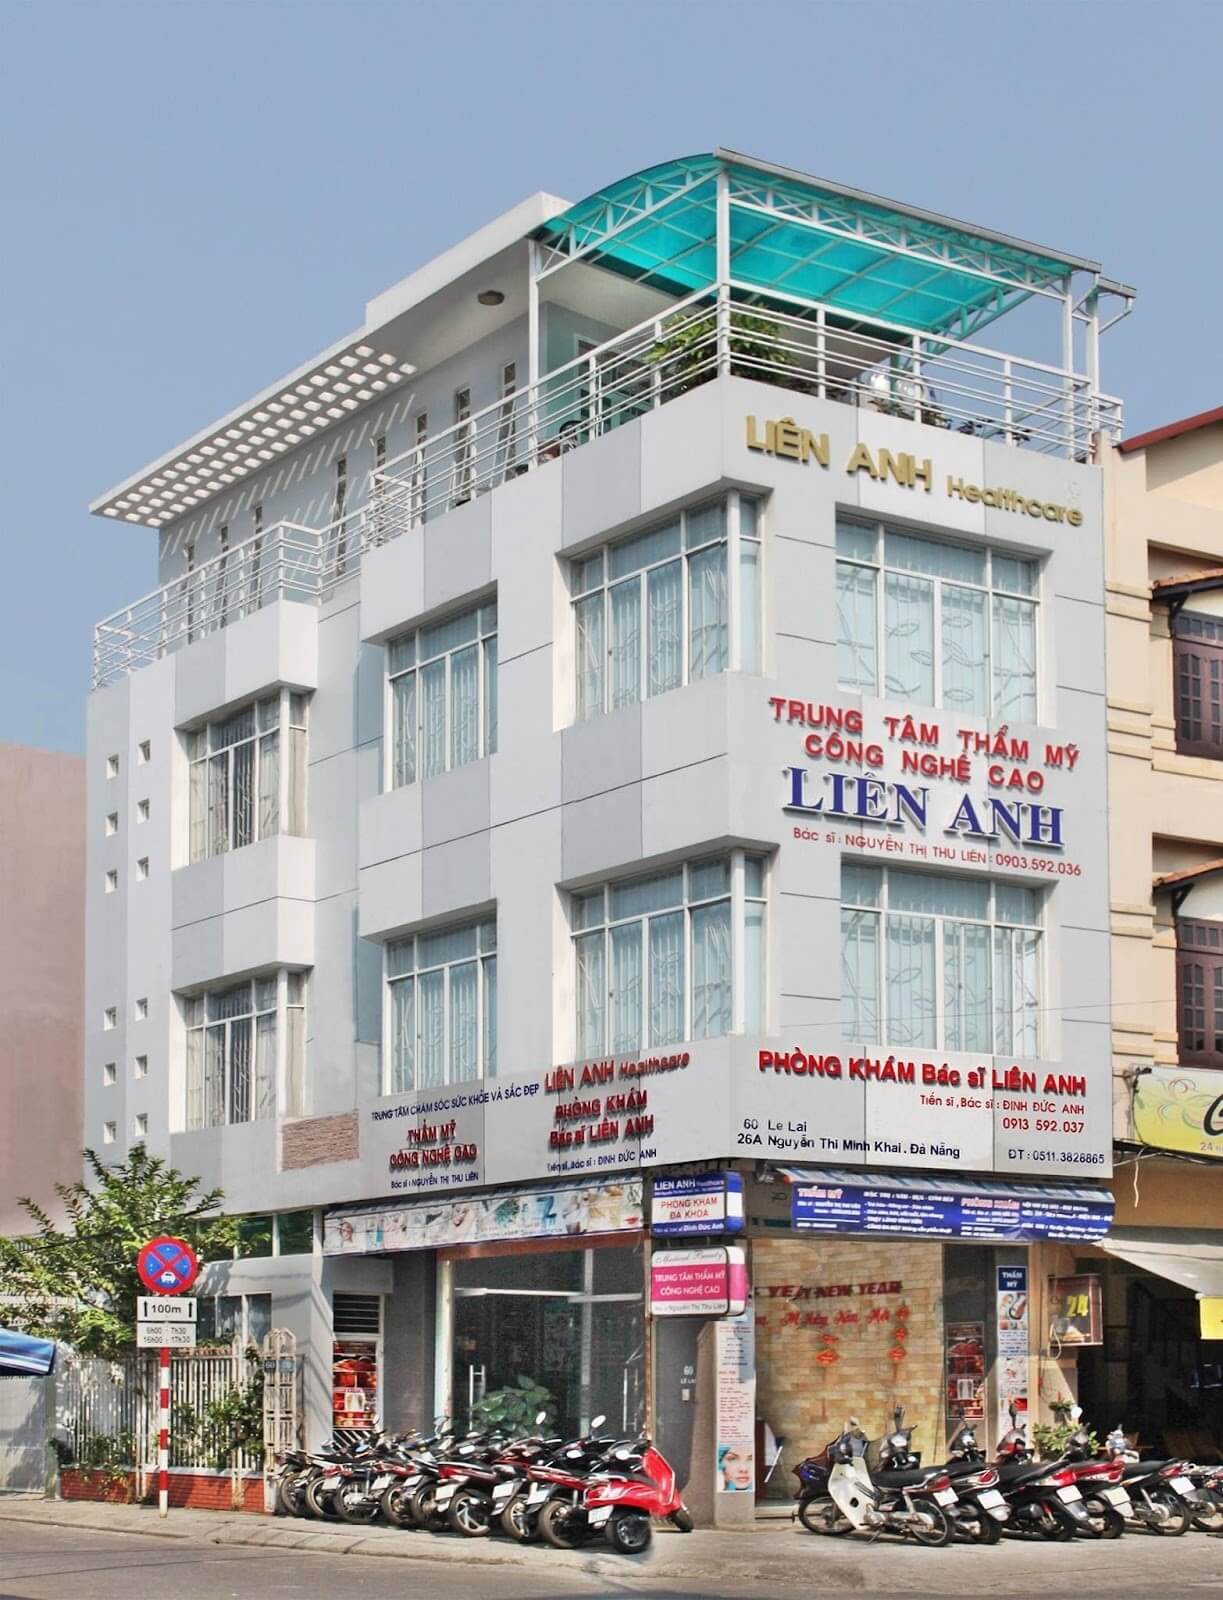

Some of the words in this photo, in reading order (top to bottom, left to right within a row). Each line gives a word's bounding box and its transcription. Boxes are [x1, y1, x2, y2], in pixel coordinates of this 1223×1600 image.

[746, 414, 831, 468] LIÊN
[846, 442, 932, 492] ANH
[946, 474, 1084, 527] Healthcare
[769, 697, 863, 733] TRUNG
[884, 714, 939, 745] TÂM
[958, 725, 1029, 760] THẨM
[1045, 743, 1079, 768] MỸ
[805, 732, 884, 767] CÔNG
[988, 765, 1045, 793] CAO
[783, 767, 929, 829] LIÊN
[945, 793, 1064, 848] ANH
[793, 827, 819, 841] Bác
[845, 834, 903, 852] NGUYỄN
[910, 843, 928, 858] THỊ
[933, 847, 956, 863] THU
[995, 853, 1082, 877] 0903.592.036
[581, 1060, 614, 1083] ANH
[758, 1047, 842, 1079] PHÒNG
[922, 1063, 960, 1087] Bác
[992, 1066, 1037, 1092] LIÊN
[1043, 1074, 1086, 1097] ANH
[372, 1110, 393, 1121] TRUNG
[491, 1087, 503, 1101] VÀ
[920, 1092, 942, 1106] Tiến
[1032, 1098, 1056, 1113] ĐỨC
[1062, 1104, 1085, 1115] ANH
[590, 1118, 619, 1141] LIÊN
[625, 1114, 654, 1136] ANH
[640, 1149, 656, 1159] ANH
[737, 1133, 762, 1145] 26A
[843, 1140, 870, 1151] Minh
[910, 1142, 926, 1155] Đà
[452, 1174, 463, 1183] THU
[676, 1178, 696, 1189] ANH
[684, 1210, 709, 1218] KHOA
[655, 1273, 678, 1282] TRUNG
[661, 1285, 682, 1296] CÔNG
[704, 1285, 720, 1294] CAO
[152, 1304, 181, 1314] 100m
